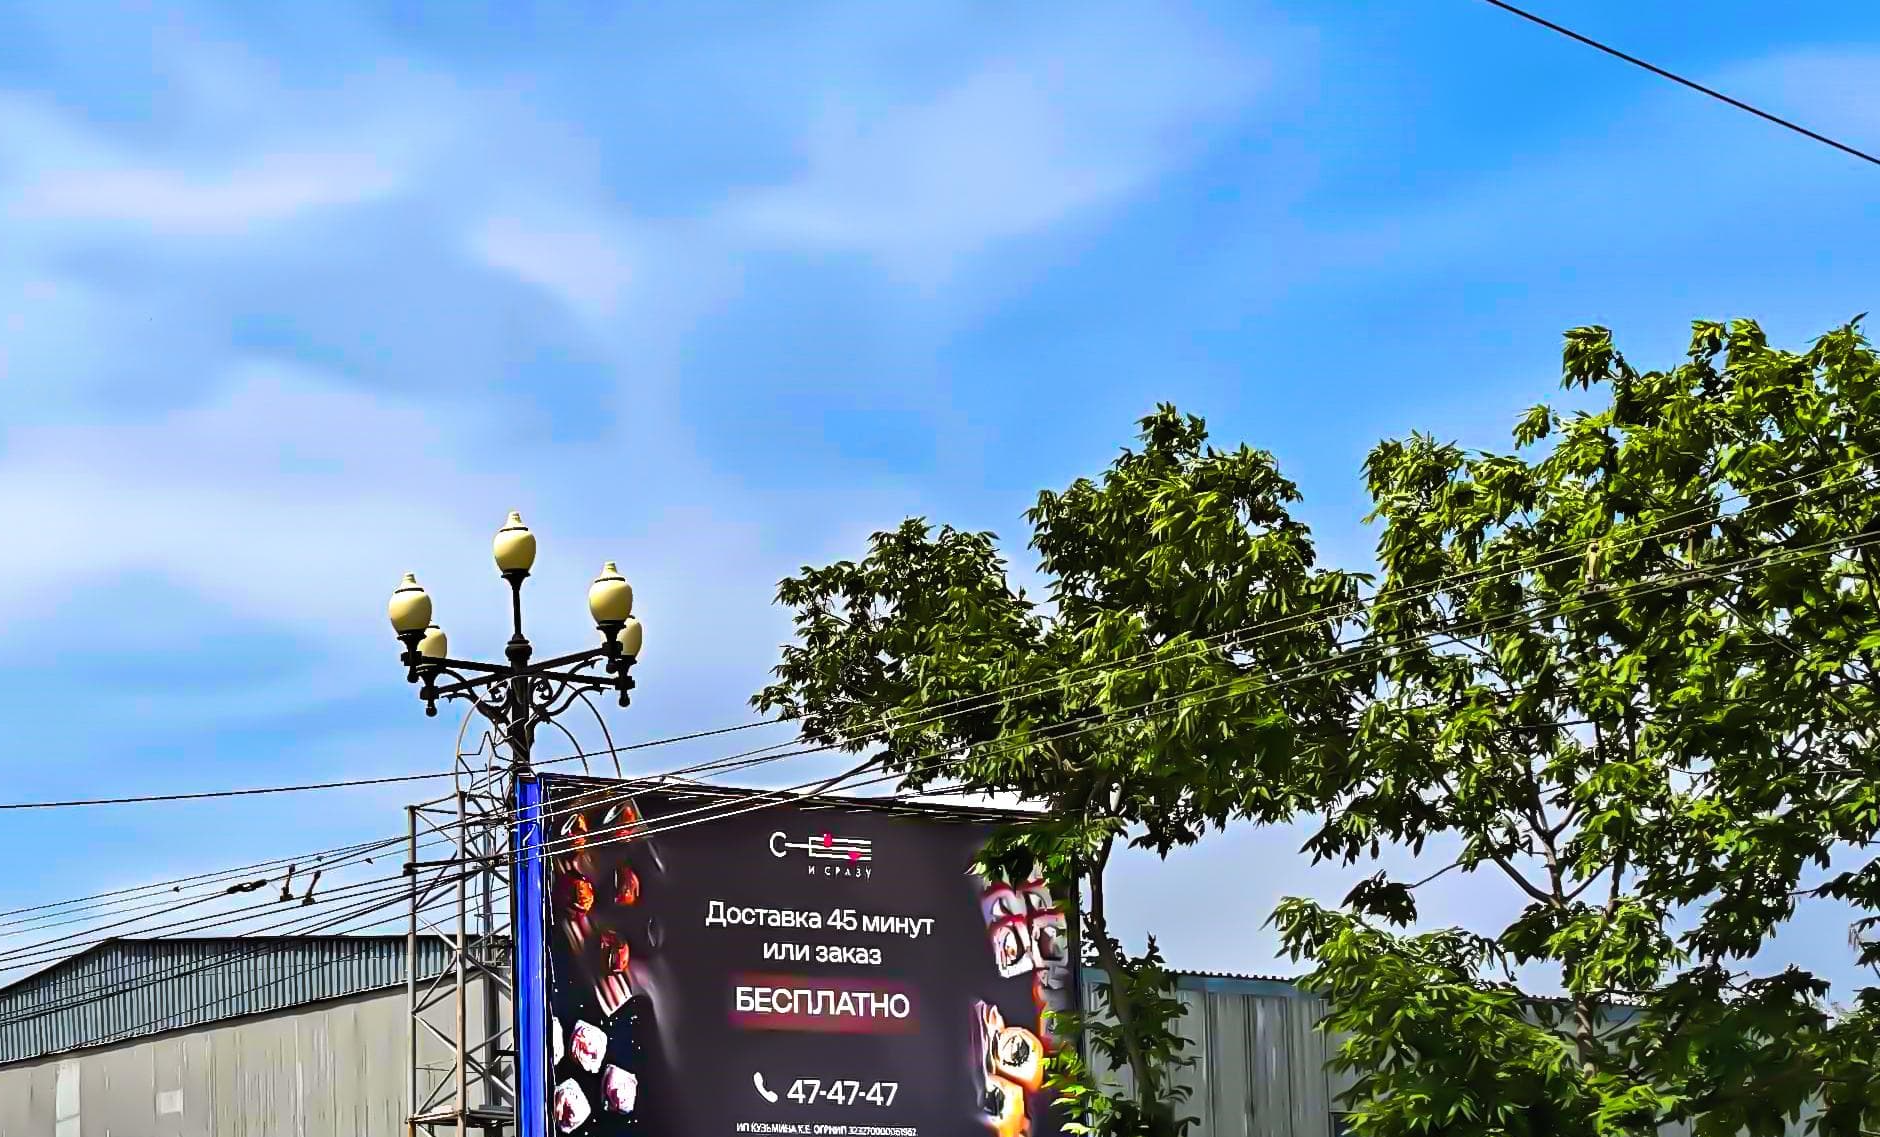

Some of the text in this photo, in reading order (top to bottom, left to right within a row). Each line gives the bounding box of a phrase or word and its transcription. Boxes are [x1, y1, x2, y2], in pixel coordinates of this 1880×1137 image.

[705, 900, 935, 938] Доставка 45 минут
[763, 942, 882, 965] или заказ
[735, 986, 910, 1018] БЕСПЛАТНО
[787, 1079, 899, 1107] 47-47-47
[736, 1122, 750, 1132] ИП
[751, 1122, 797, 1134] КУЗЬМИНА
